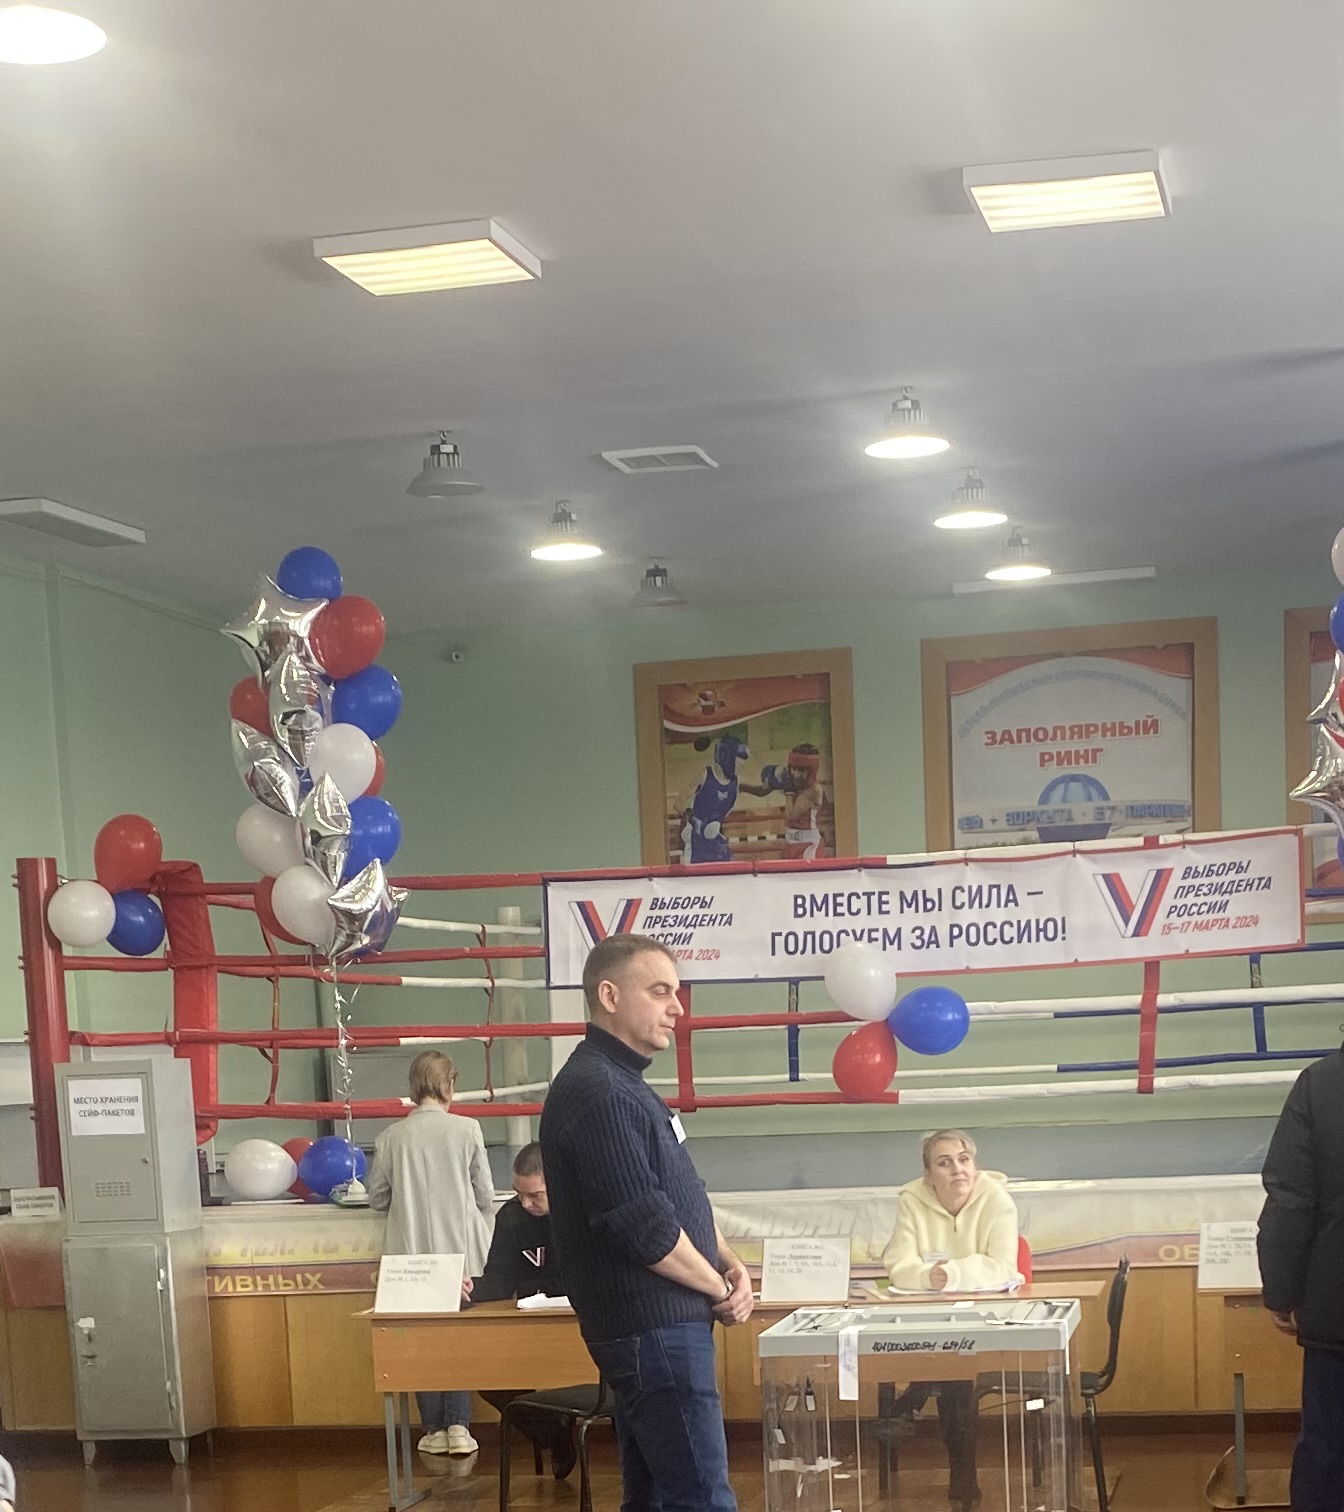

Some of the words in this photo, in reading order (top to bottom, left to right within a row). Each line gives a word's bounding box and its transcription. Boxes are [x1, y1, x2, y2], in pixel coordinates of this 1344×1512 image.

[984, 714, 1159, 747] ЗАПОЛЯРНЫЙ
[1039, 748, 1103, 768] РИНГ
[1181, 860, 1251, 880] ВЫБОРЫ
[1173, 876, 1272, 899] ПРЕЗИДЕНТА
[649, 896, 714, 911] ВЫБОРЫ
[793, 890, 891, 918] ВМЕСТЕ
[899, 887, 943, 914] МЫ
[951, 883, 1020, 910] СИЛА
[1166, 899, 1230, 919] РОССИИ
[642, 913, 733, 929] ПРЕЗИДЕНТА
[1192, 917, 1231, 933] МАРТА
[1232, 914, 1260, 930] 2024
[910, 925, 941, 951] ЗА
[949, 916, 1067, 948] РОССИЮ!
[695, 949, 720, 961] 2024
[73, 1096, 98, 1105] МЕСТО
[99, 1095, 139, 1104] ХРАНЕНИЯ
[78, 1108, 135, 1118] СЕЙФ-ПАКЕТОВ
